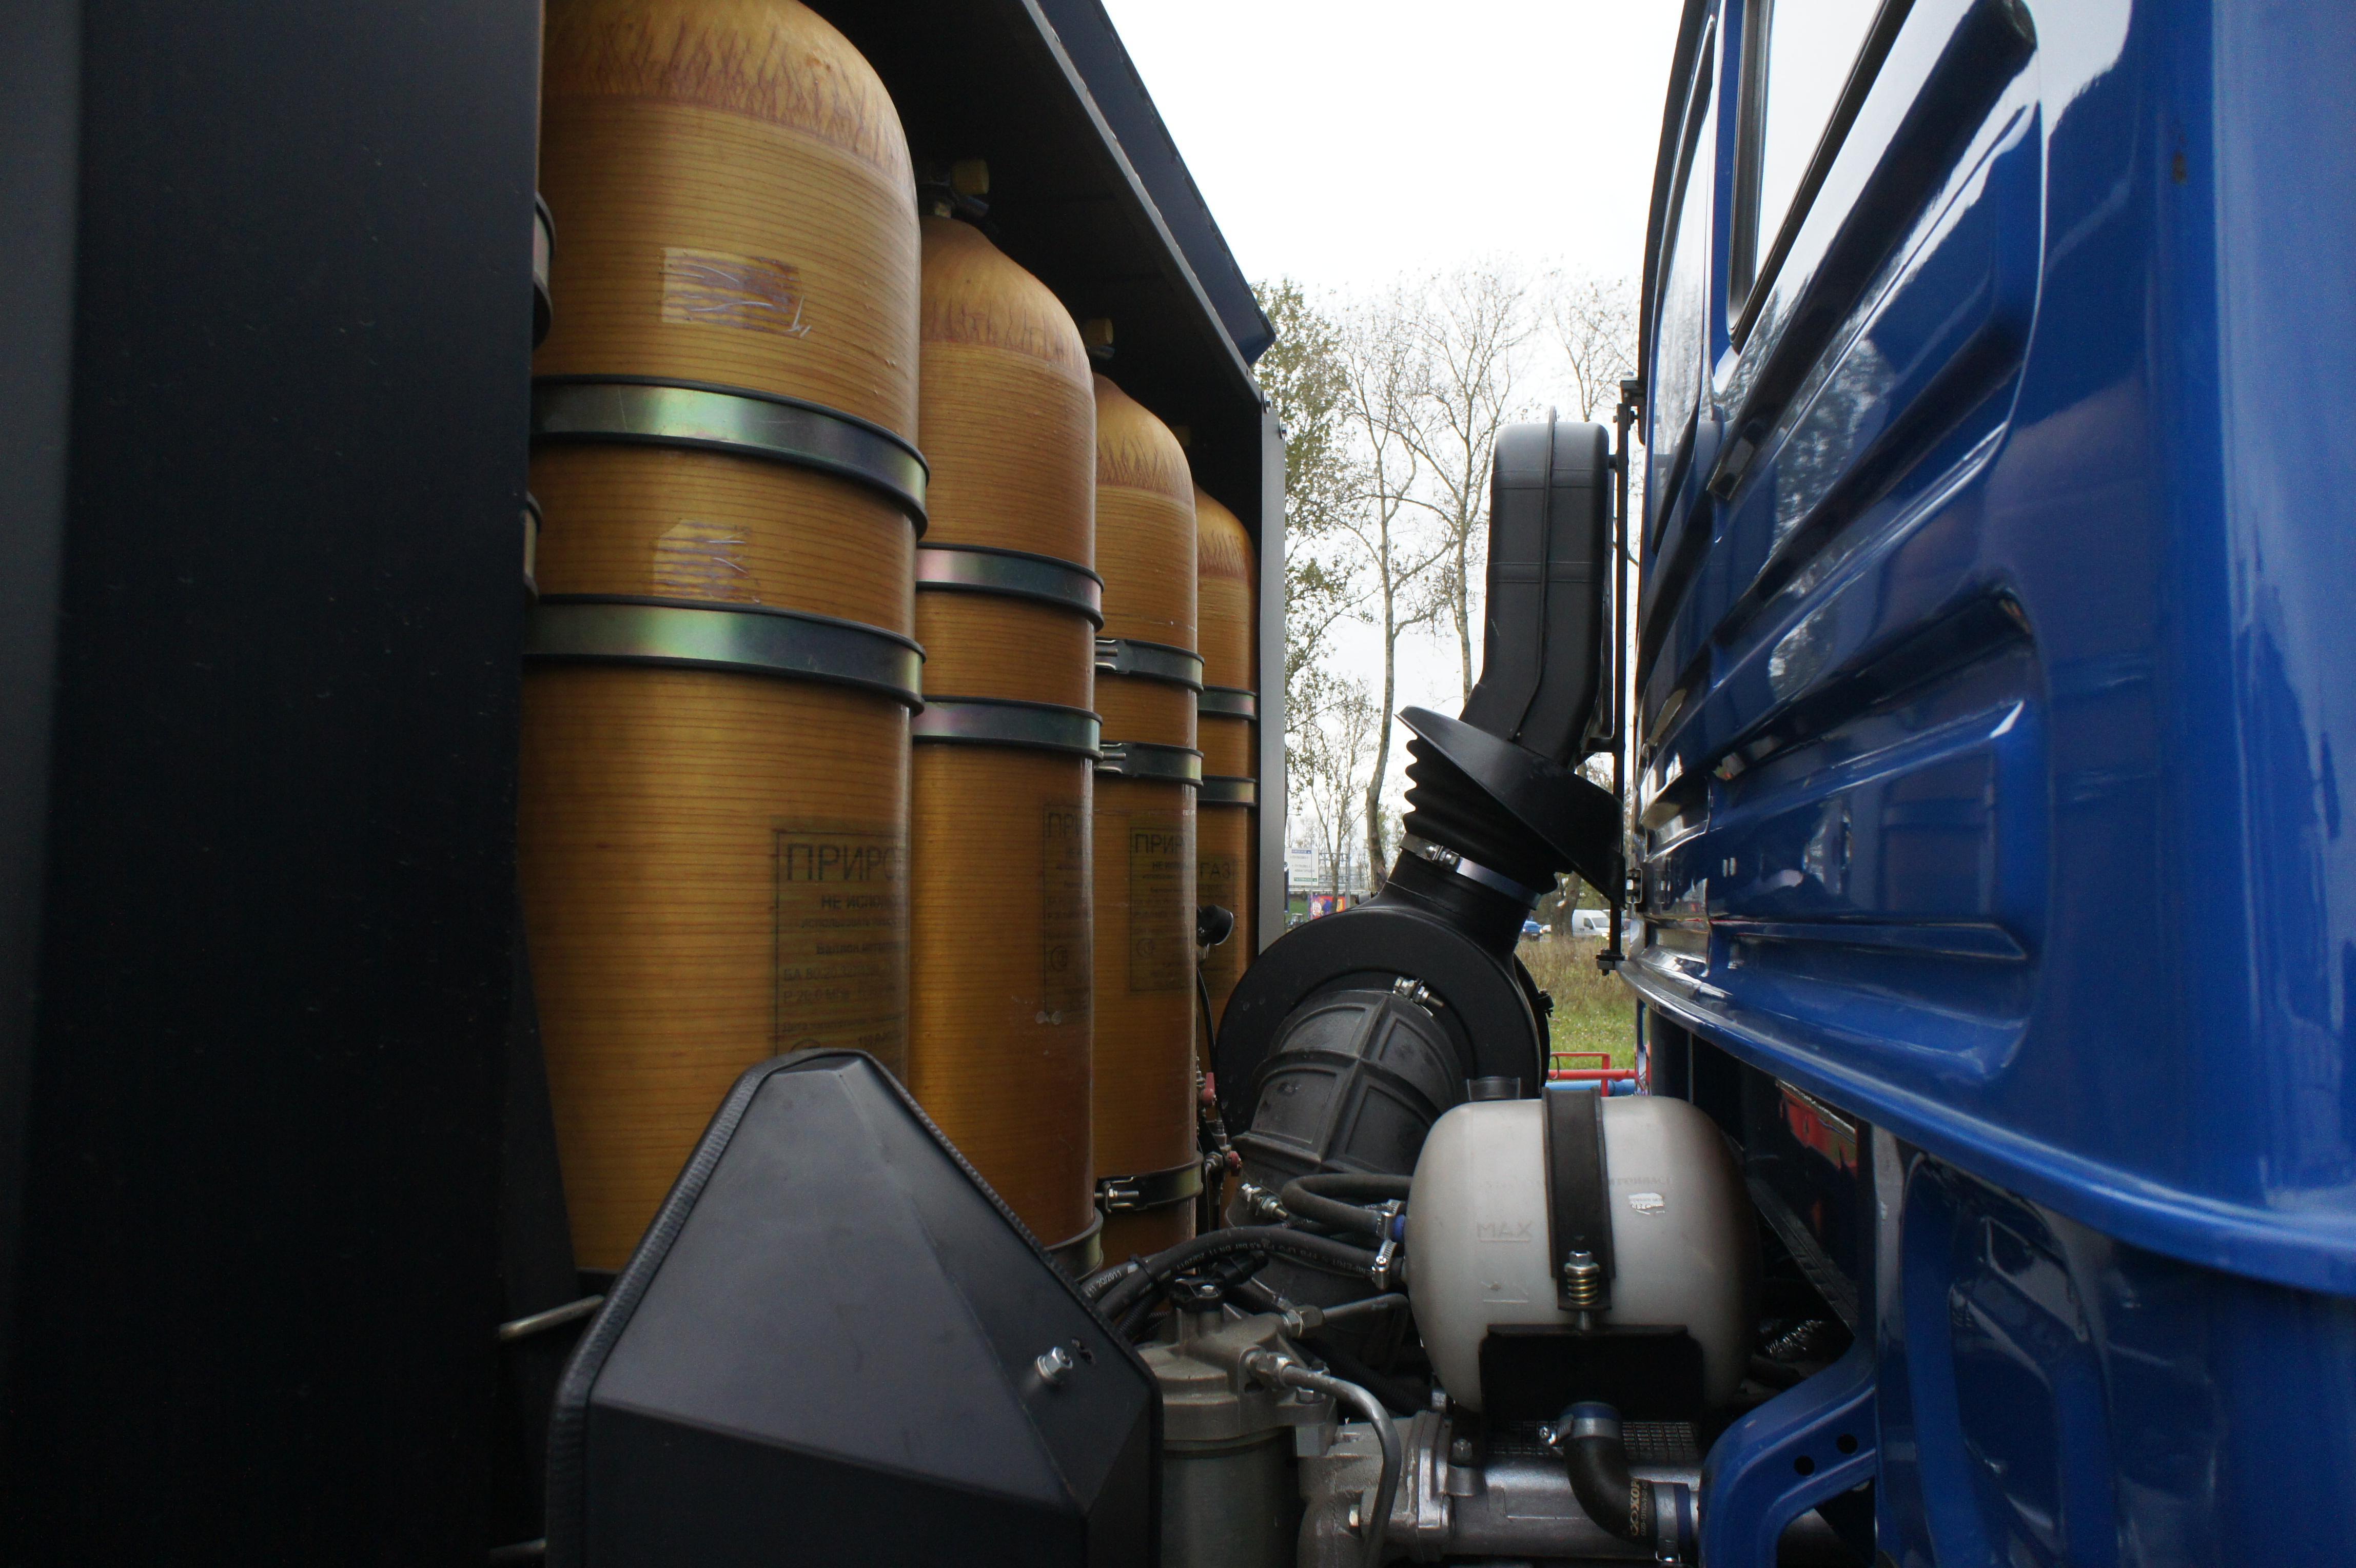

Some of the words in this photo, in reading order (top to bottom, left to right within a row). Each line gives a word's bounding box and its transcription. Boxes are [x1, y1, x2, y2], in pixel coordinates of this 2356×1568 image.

[787, 843, 900, 881] ПРИРО
[1200, 862, 1232, 879] ГАЗ
[1477, 1221, 1533, 1238] MAX
